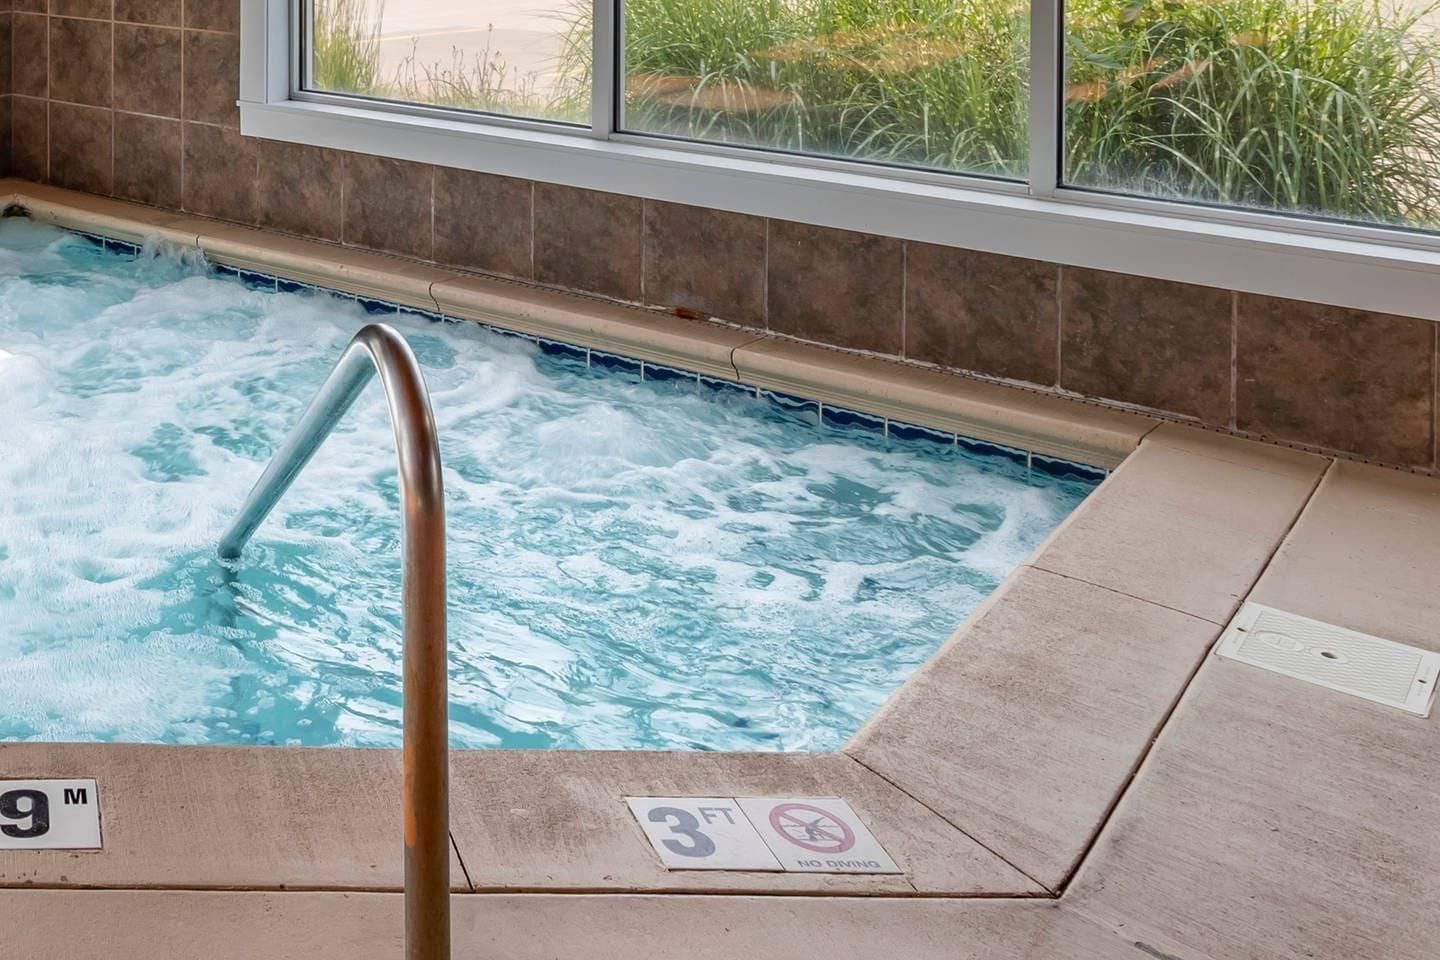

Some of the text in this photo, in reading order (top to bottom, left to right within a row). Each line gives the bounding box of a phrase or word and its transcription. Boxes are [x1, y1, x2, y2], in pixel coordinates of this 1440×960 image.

[63, 788, 87, 805] M
[647, 806, 736, 858] 3 FT
[797, 859, 881, 869] NO DIVING
